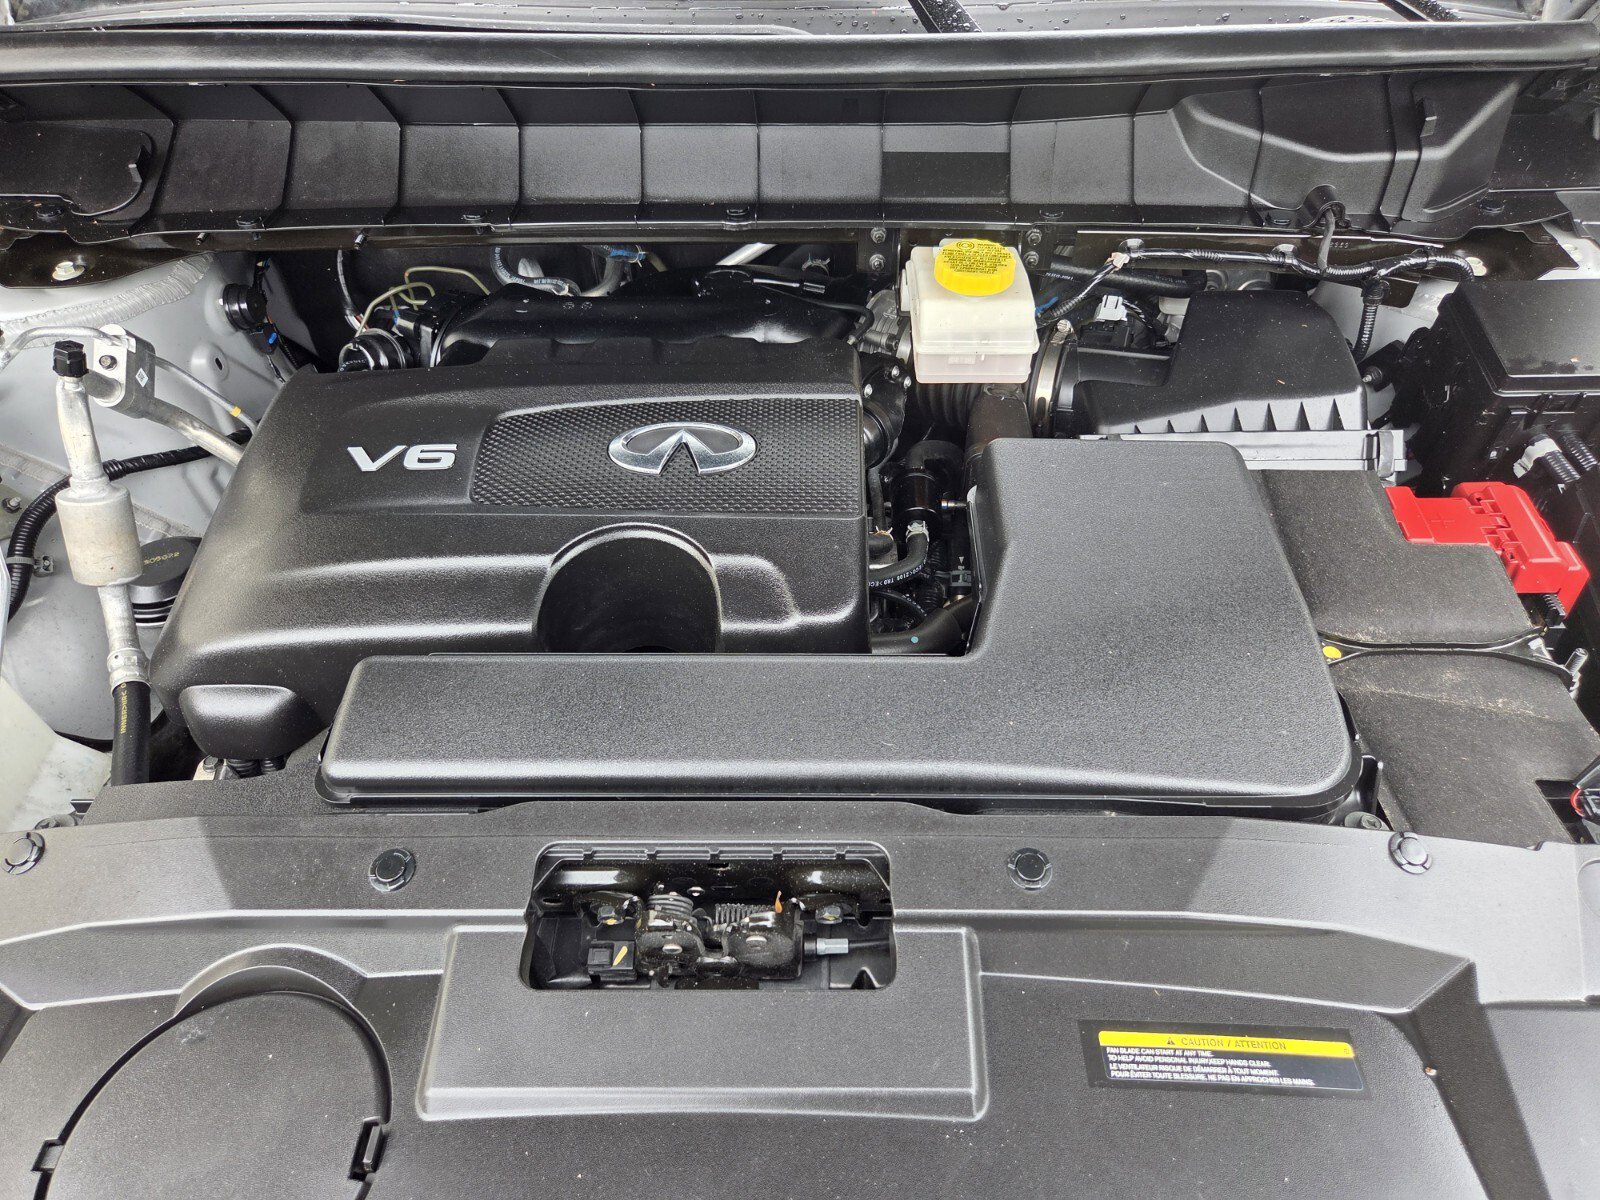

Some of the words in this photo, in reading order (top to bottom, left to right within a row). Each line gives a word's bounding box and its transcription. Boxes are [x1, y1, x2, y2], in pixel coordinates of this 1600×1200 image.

[346, 443, 458, 472] V6
[1180, 1038, 1224, 1046] CAUTION
[1234, 1040, 1287, 1050] ATTENTION
